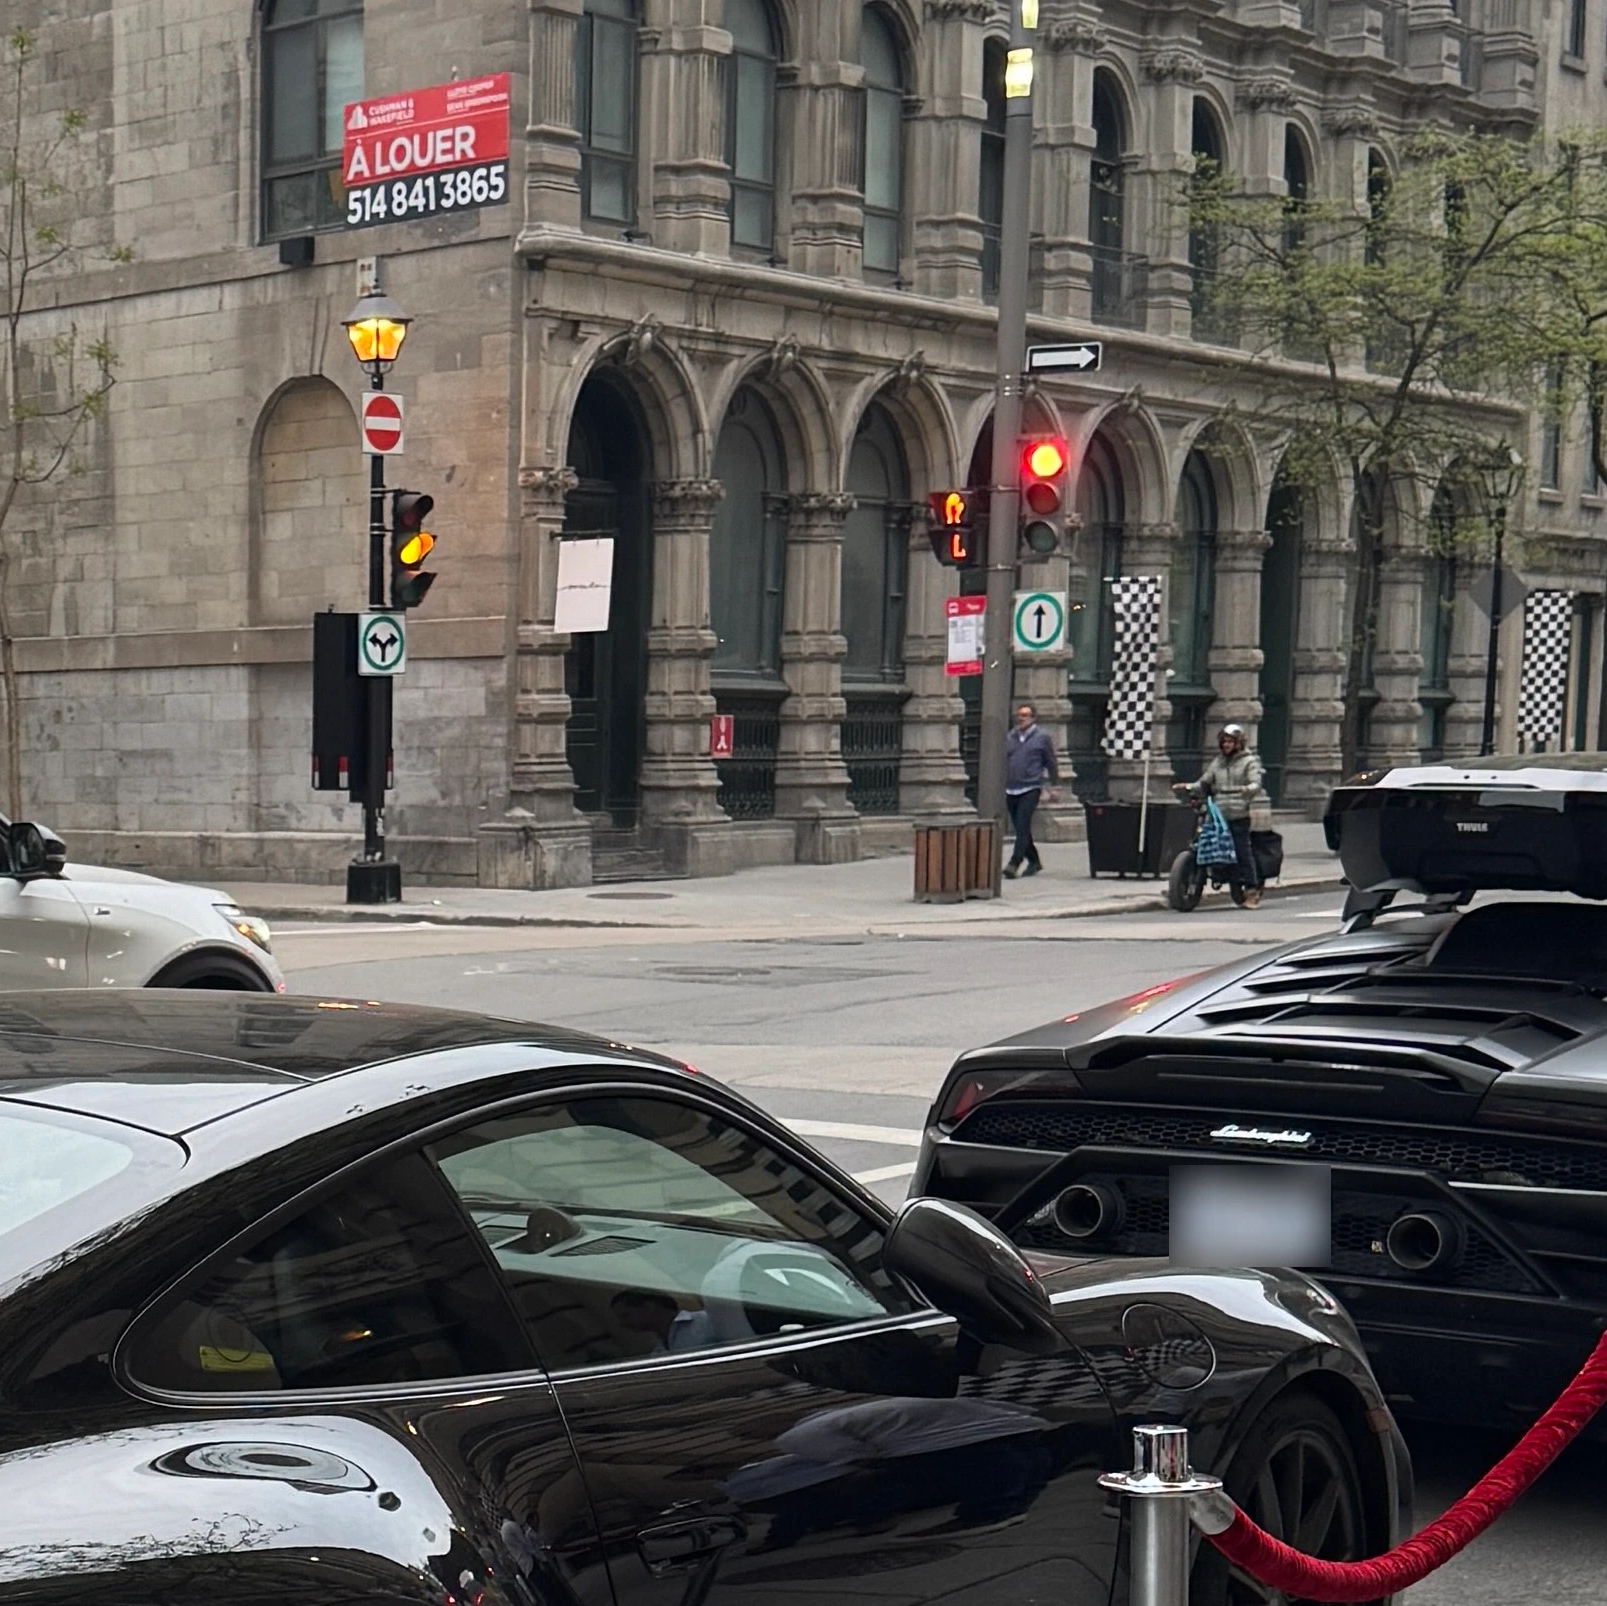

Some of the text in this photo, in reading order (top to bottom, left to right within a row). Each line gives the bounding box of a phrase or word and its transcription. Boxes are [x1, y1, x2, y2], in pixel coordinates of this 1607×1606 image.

[347, 126, 476, 181] À LOUER
[347, 165, 505, 224] 514 841 3865
